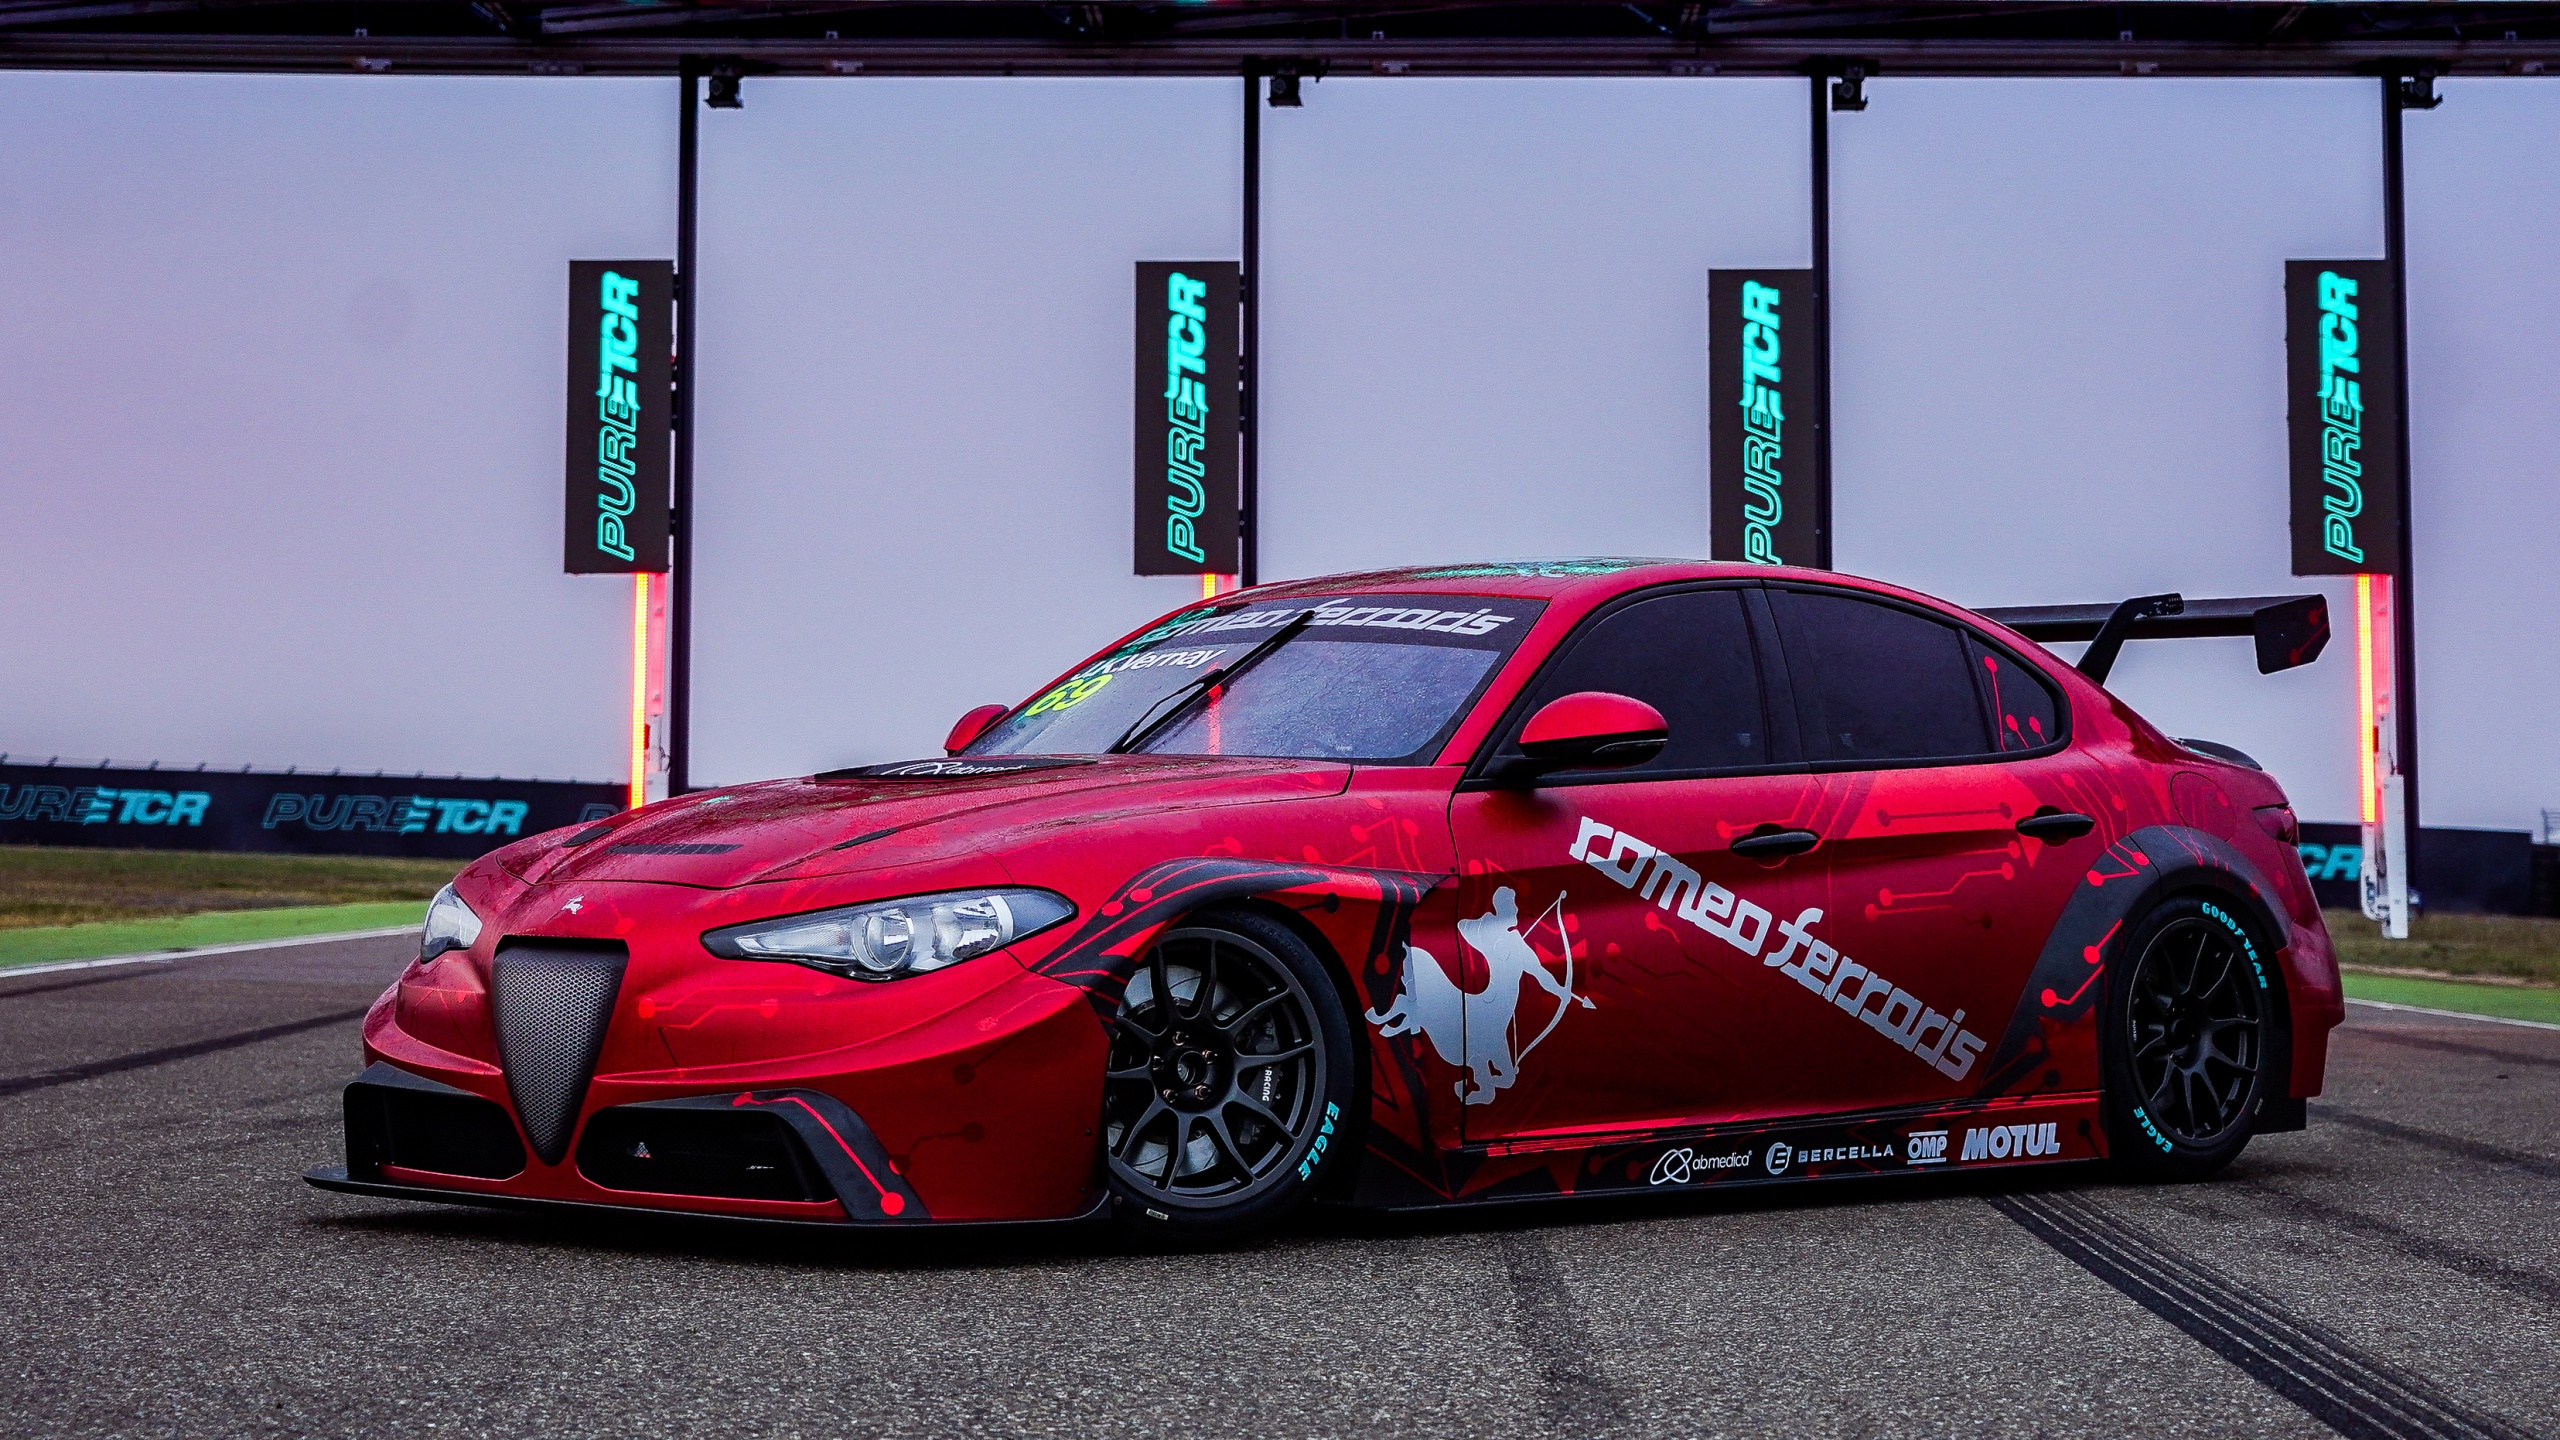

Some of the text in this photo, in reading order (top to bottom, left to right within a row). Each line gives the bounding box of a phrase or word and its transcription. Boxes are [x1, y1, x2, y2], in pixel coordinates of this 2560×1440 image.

[1024, 673, 1114, 717] 69
[1569, 815, 1988, 1082] romeo ferraris
[2201, 901, 2268, 989] GOODYEAR
[1261, 1069, 1273, 1102] RACING
[1297, 1100, 1340, 1182] EAGLE
[1907, 1135, 1948, 1159] OMP
[1960, 1122, 2061, 1161] MOTUL
[2132, 1105, 2174, 1153] EAGLE
[1797, 1144, 1894, 1163] BERCELLA
